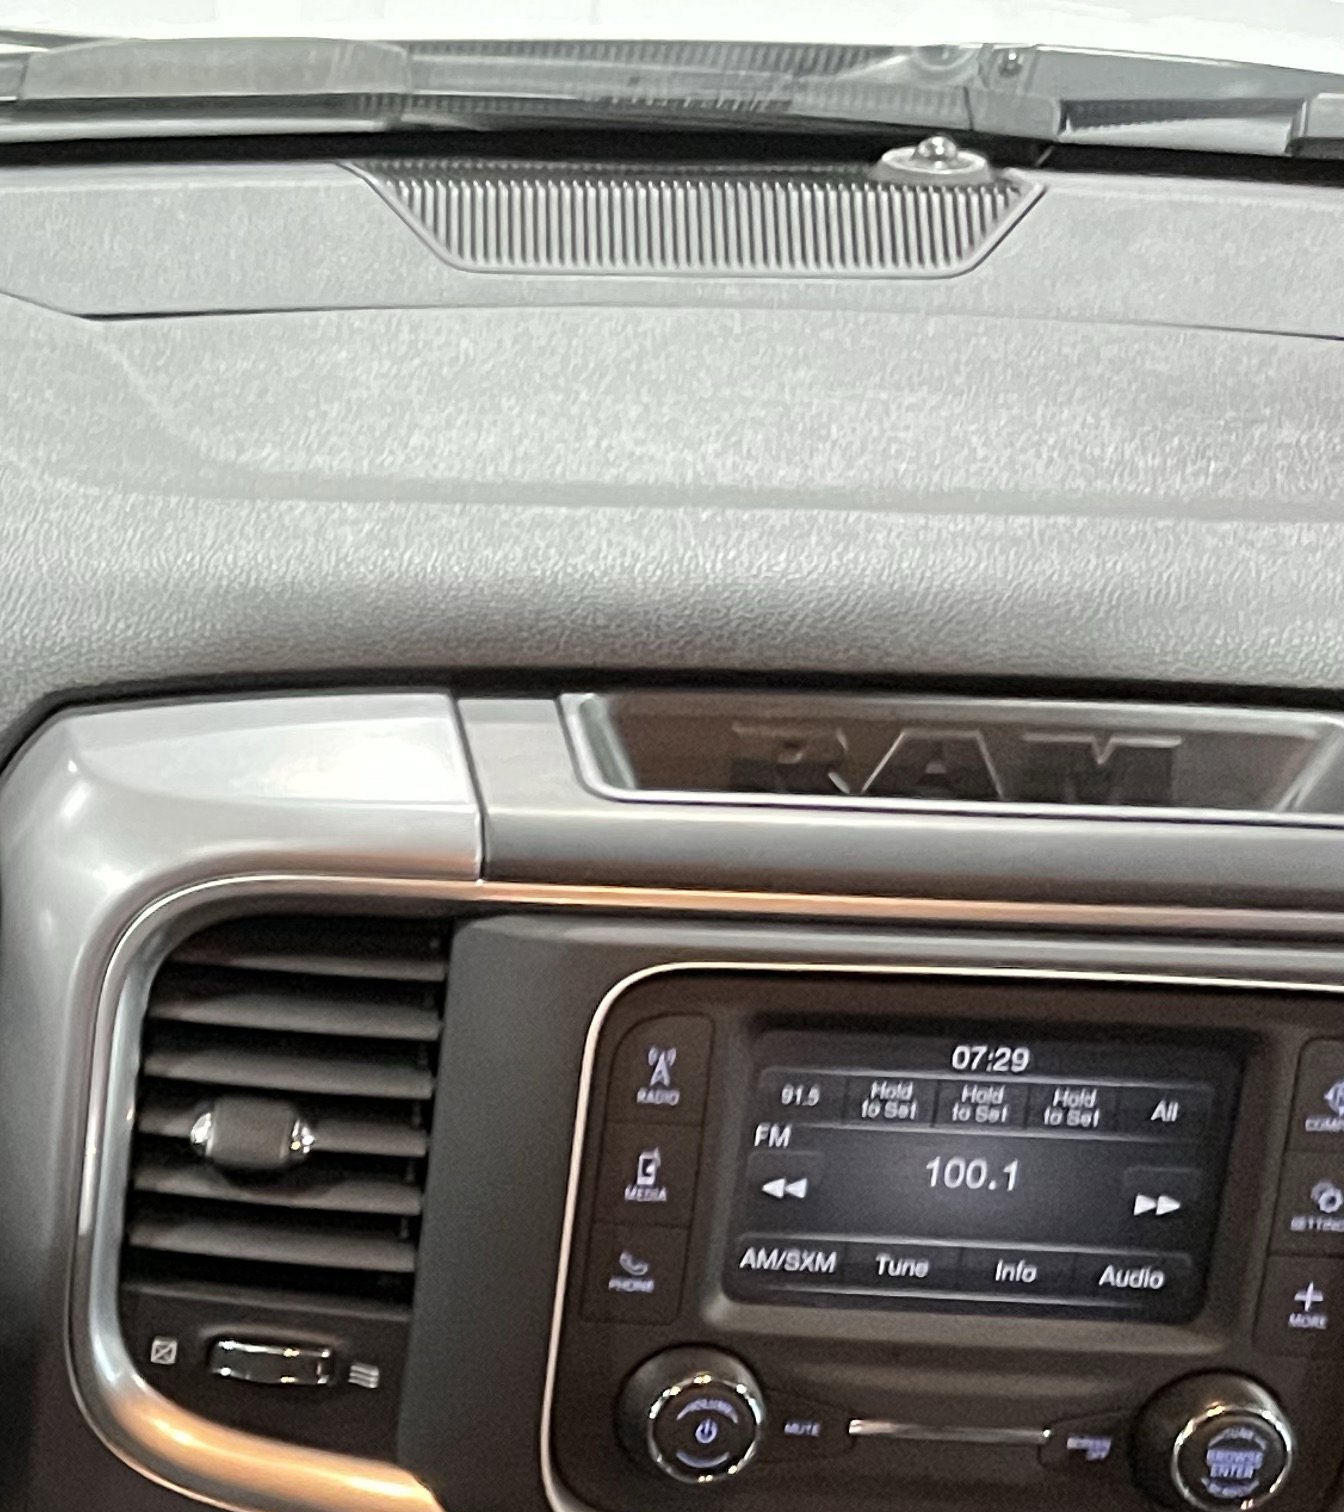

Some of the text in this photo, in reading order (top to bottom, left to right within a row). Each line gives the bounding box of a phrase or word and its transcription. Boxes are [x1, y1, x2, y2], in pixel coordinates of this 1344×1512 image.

[952, 1045, 1029, 1073] 07:29
[637, 1088, 680, 1106] RADIO
[871, 1081, 913, 1101] Hold
[962, 1084, 1006, 1105] Hold
[1053, 1088, 1098, 1109] Hold
[1151, 1100, 1179, 1123] All
[862, 1099, 917, 1121] to Set
[952, 1102, 1008, 1124] to Set
[1044, 1106, 1100, 1128] to Set
[754, 1123, 792, 1148] FM
[926, 1156, 1020, 1192] 100.1
[624, 1185, 667, 1202] MEDIA
[739, 1248, 1164, 1290] AM/SXM Tune Info Audio
